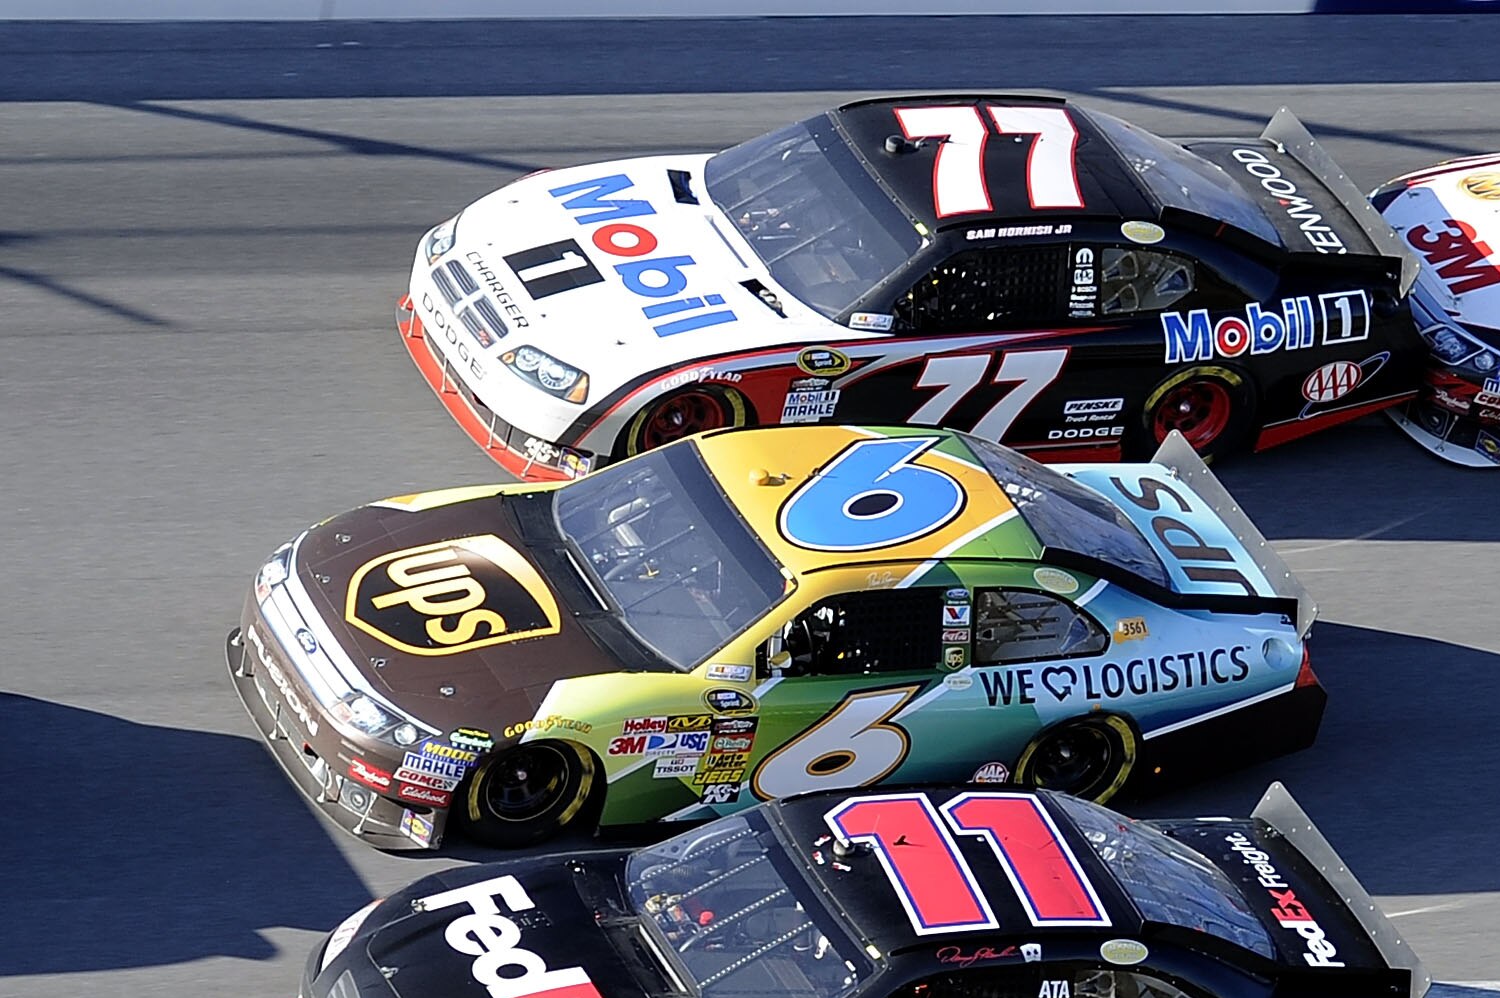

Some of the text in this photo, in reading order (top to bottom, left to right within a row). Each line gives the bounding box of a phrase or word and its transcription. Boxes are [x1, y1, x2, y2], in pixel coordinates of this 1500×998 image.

[894, 105, 1085, 219] 77
[966, 224, 1073, 240] SAM HORNISH JR
[549, 174, 737, 338] Mobil
[465, 251, 529, 329] CHARGER
[422, 292, 484, 382] DODGE
[1161, 296, 1313, 364] Mobil
[1305, 362, 1362, 401] AAA
[789, 393, 824, 405] Mobil
[906, 348, 1070, 443] 77
[784, 403, 834, 417] MAHLE
[1066, 400, 1121, 412] PENSKE
[1048, 426, 1125, 439] DODGE
[777, 436, 966, 552] 6
[371, 550, 506, 646] ups
[1122, 620, 1147, 636] 3561
[247, 624, 319, 737] FUSION
[978, 645, 1250, 707] WE LOGISTICS
[624, 718, 666, 733] Holley
[608, 735, 647, 755] 3M
[680, 733, 708, 751] USG
[749, 679, 933, 802] 6
[423, 742, 478, 762] MOOG
[719, 754, 743, 762] Auto
[404, 754, 465, 779] MAHLE
[656, 765, 696, 773] TISSOT
[715, 761, 747, 769] Meter
[399, 770, 442, 787] COMP
[694, 770, 744, 785] JEGS
[824, 792, 1112, 936] 11
[1268, 889, 1346, 968] FedEx
[1038, 980, 1070, 998] ATA
